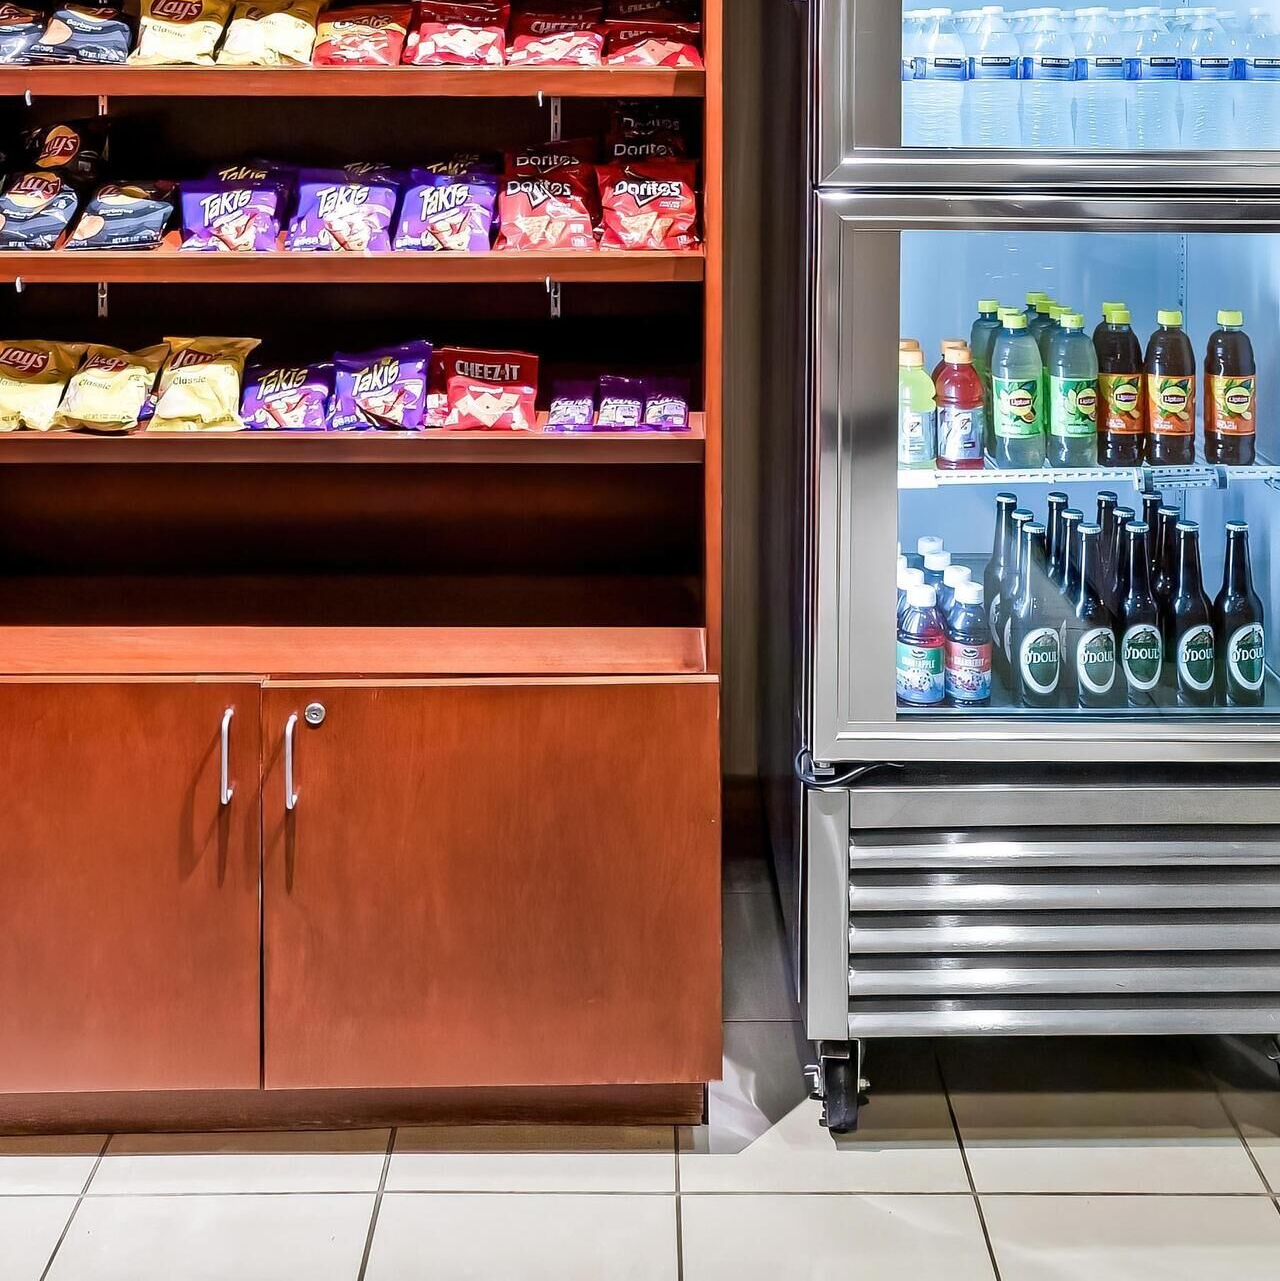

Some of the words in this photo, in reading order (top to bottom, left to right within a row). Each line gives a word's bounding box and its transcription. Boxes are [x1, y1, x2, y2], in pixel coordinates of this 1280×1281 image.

[516, 155, 580, 167] Doritos
[506, 180, 572, 197] Doritos
[614, 180, 682, 197] Doritos
[200, 190, 252, 226] Takis
[317, 185, 370, 218] Takis
[419, 184, 469, 221] Takis
[78, 378, 111, 390] Classic
[173, 375, 206, 385] Classic
[257, 368, 308, 400] Takis
[351, 360, 400, 396] Takis
[1116, 394, 1137, 402] Lipton
[1163, 395, 1186, 404] Lipton
[1228, 396, 1249, 404] Lipton
